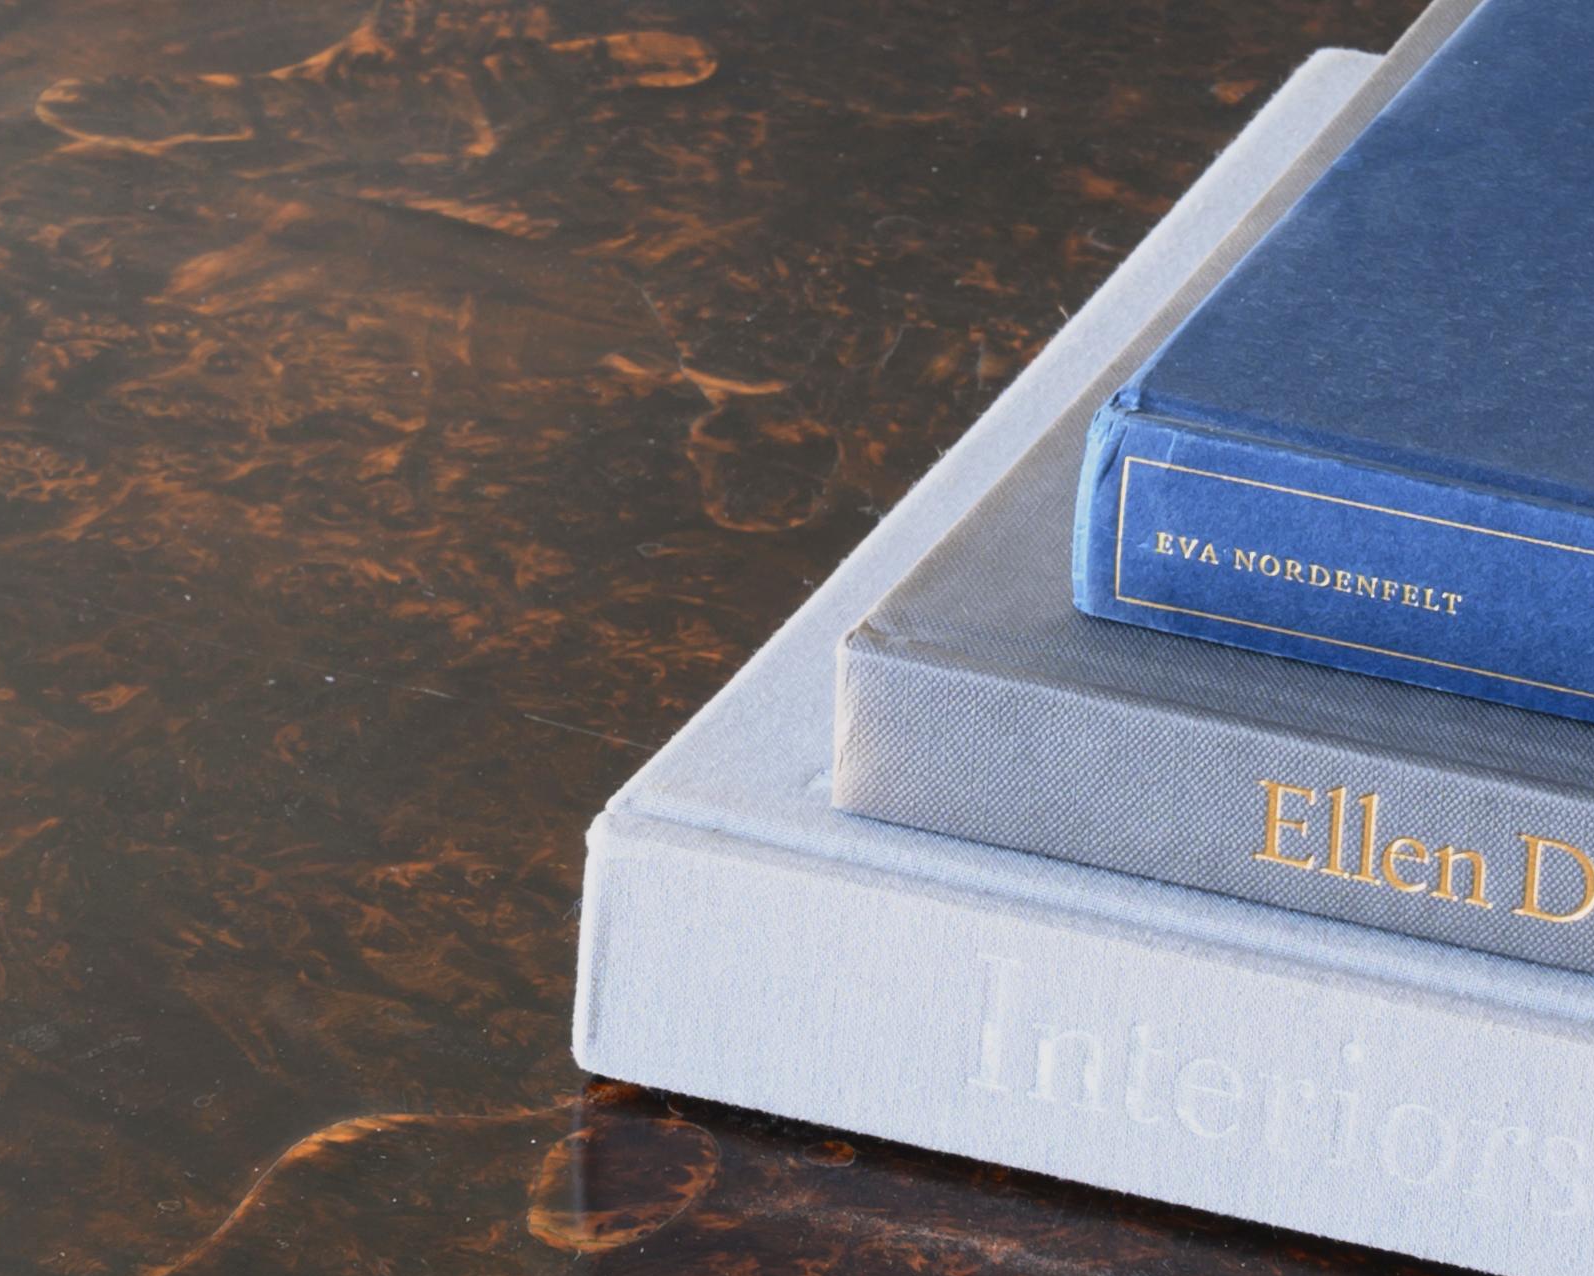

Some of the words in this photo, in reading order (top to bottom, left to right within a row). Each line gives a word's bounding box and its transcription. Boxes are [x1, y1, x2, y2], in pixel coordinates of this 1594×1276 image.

[1155, 531, 1219, 565] EVA
[1234, 547, 1464, 616] NORDENFELT
[1253, 779, 1494, 911] Ellen
[967, 950, 1590, 1219] Interiors
